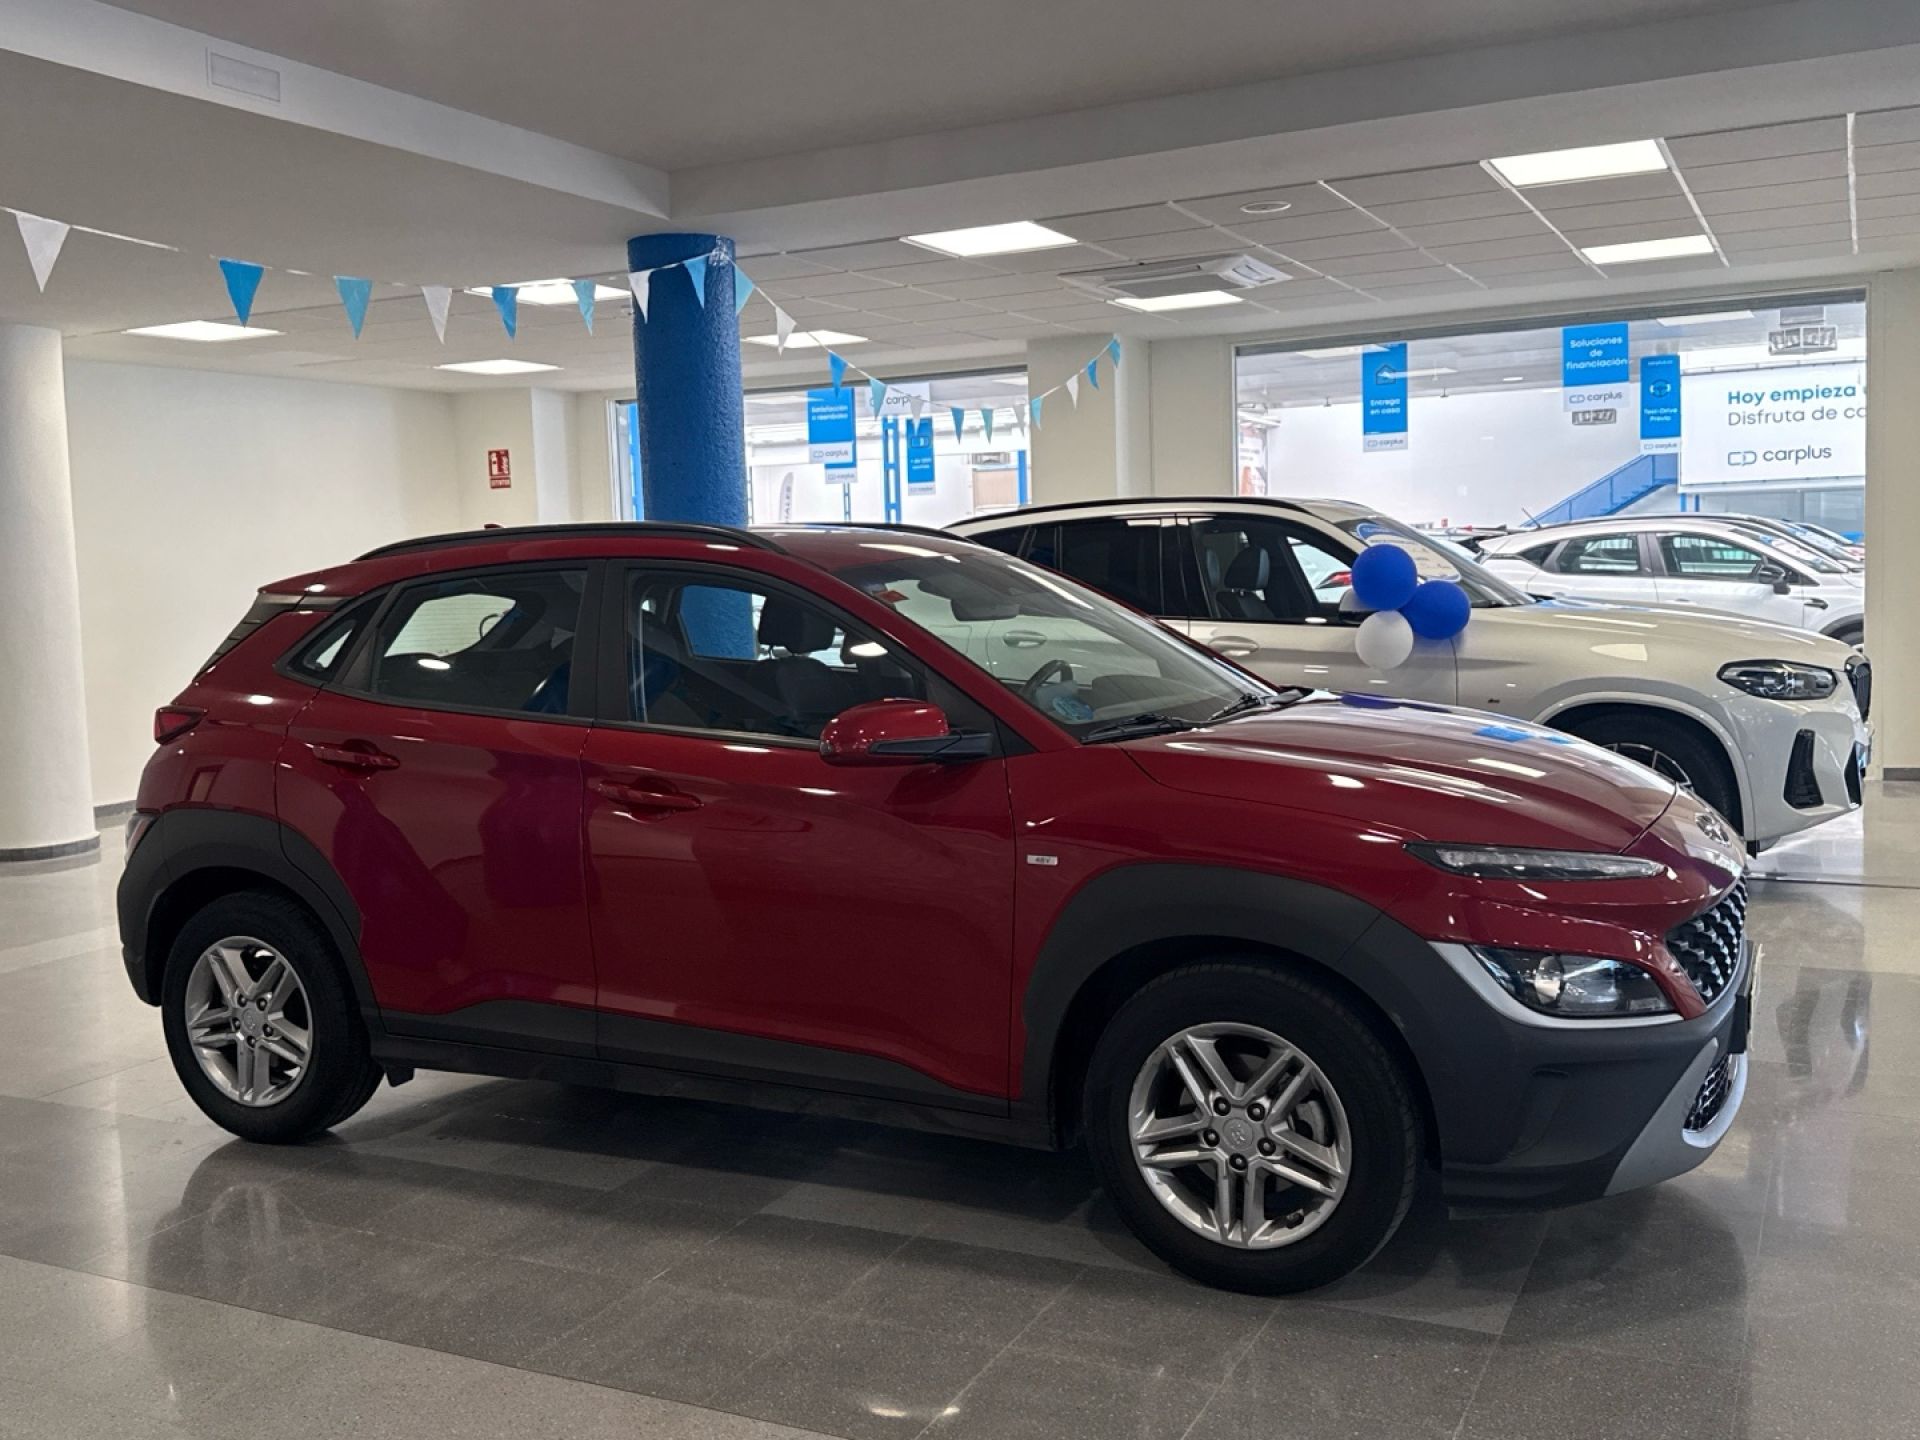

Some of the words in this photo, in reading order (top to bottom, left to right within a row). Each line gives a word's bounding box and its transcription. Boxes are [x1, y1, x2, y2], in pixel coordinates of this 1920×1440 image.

[1570, 337, 1623, 349] Soluciones
[1589, 348, 1603, 358] de
[1566, 358, 1628, 370] financiación
[1587, 391, 1622, 403] carplus
[1728, 390, 1766, 406] Hoy
[1770, 384, 1857, 403] empieza
[1370, 399, 1401, 407] Entrega
[1728, 409, 1806, 426] Disfruta
[1811, 406, 1838, 421] de
[1380, 439, 1404, 447] carplus
[825, 450, 849, 458] carplus
[1762, 445, 1833, 465] carplus
